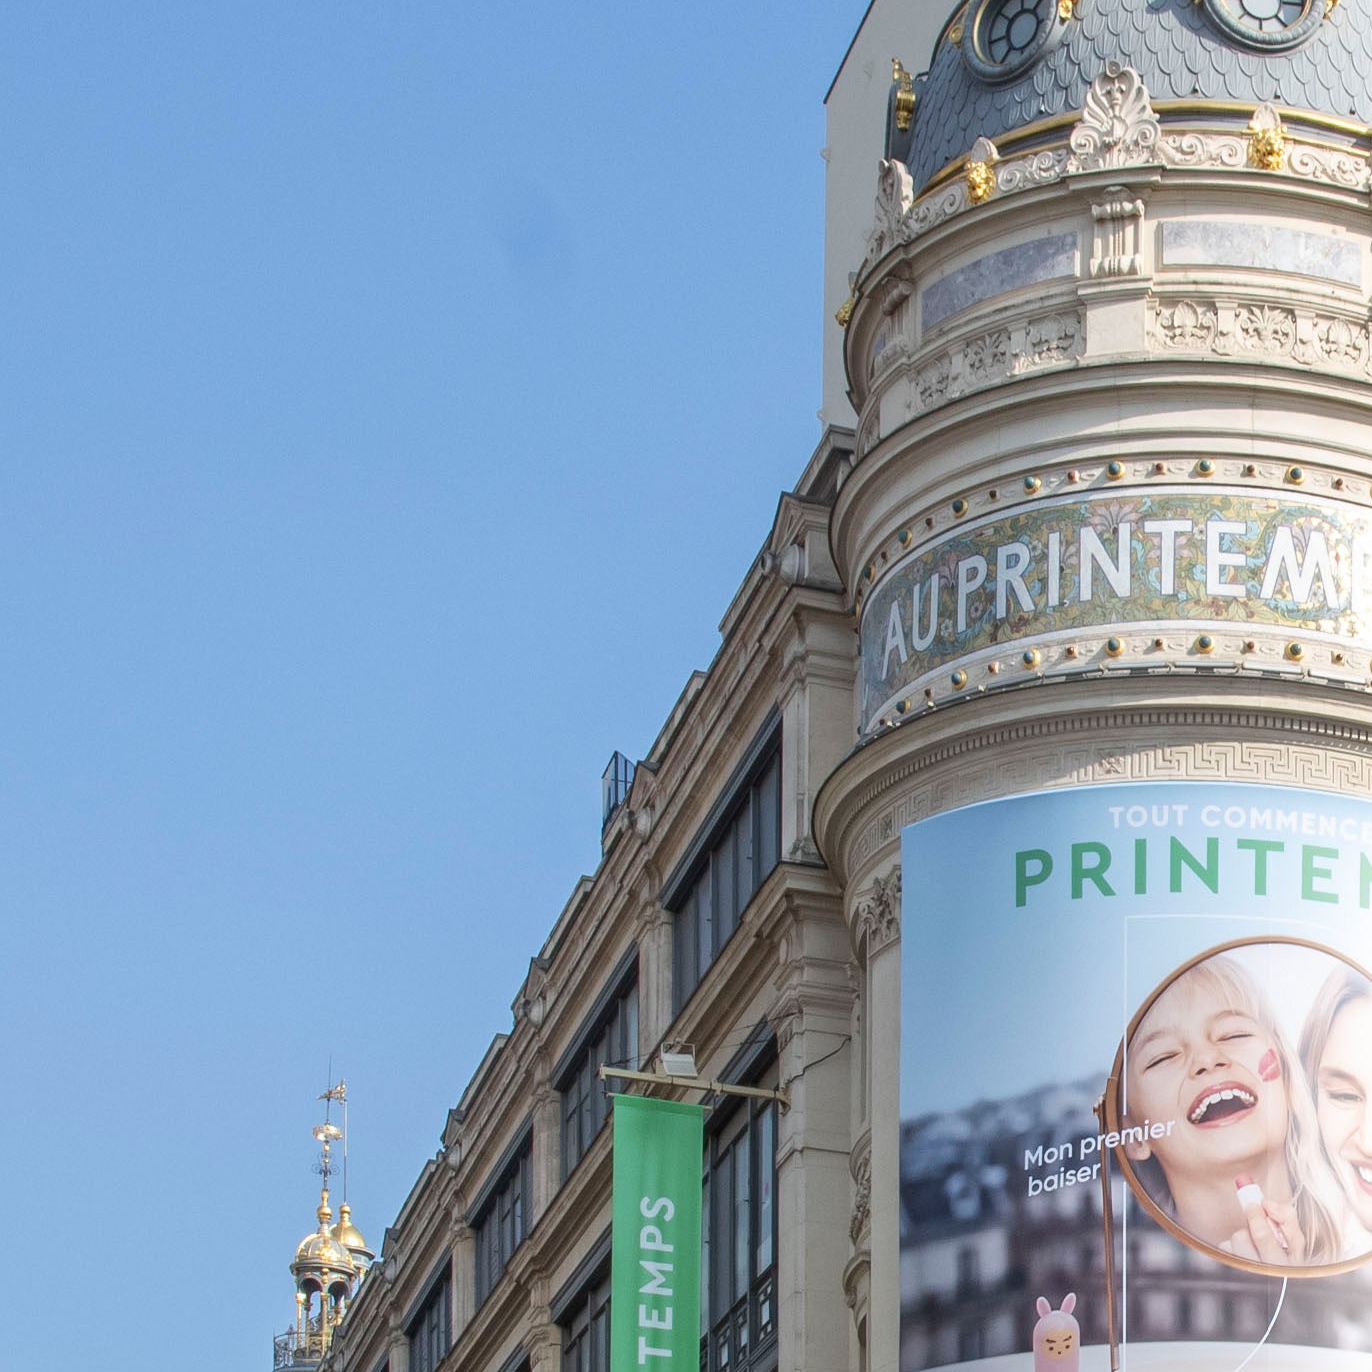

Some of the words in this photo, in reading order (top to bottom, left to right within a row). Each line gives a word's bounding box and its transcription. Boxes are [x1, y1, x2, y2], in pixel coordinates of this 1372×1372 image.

[1108, 804, 1190, 829] TOUT
[1024, 1142, 1073, 1171] Mon
[1080, 1120, 1176, 1161] premier
[1028, 1162, 1102, 1197] baiser
